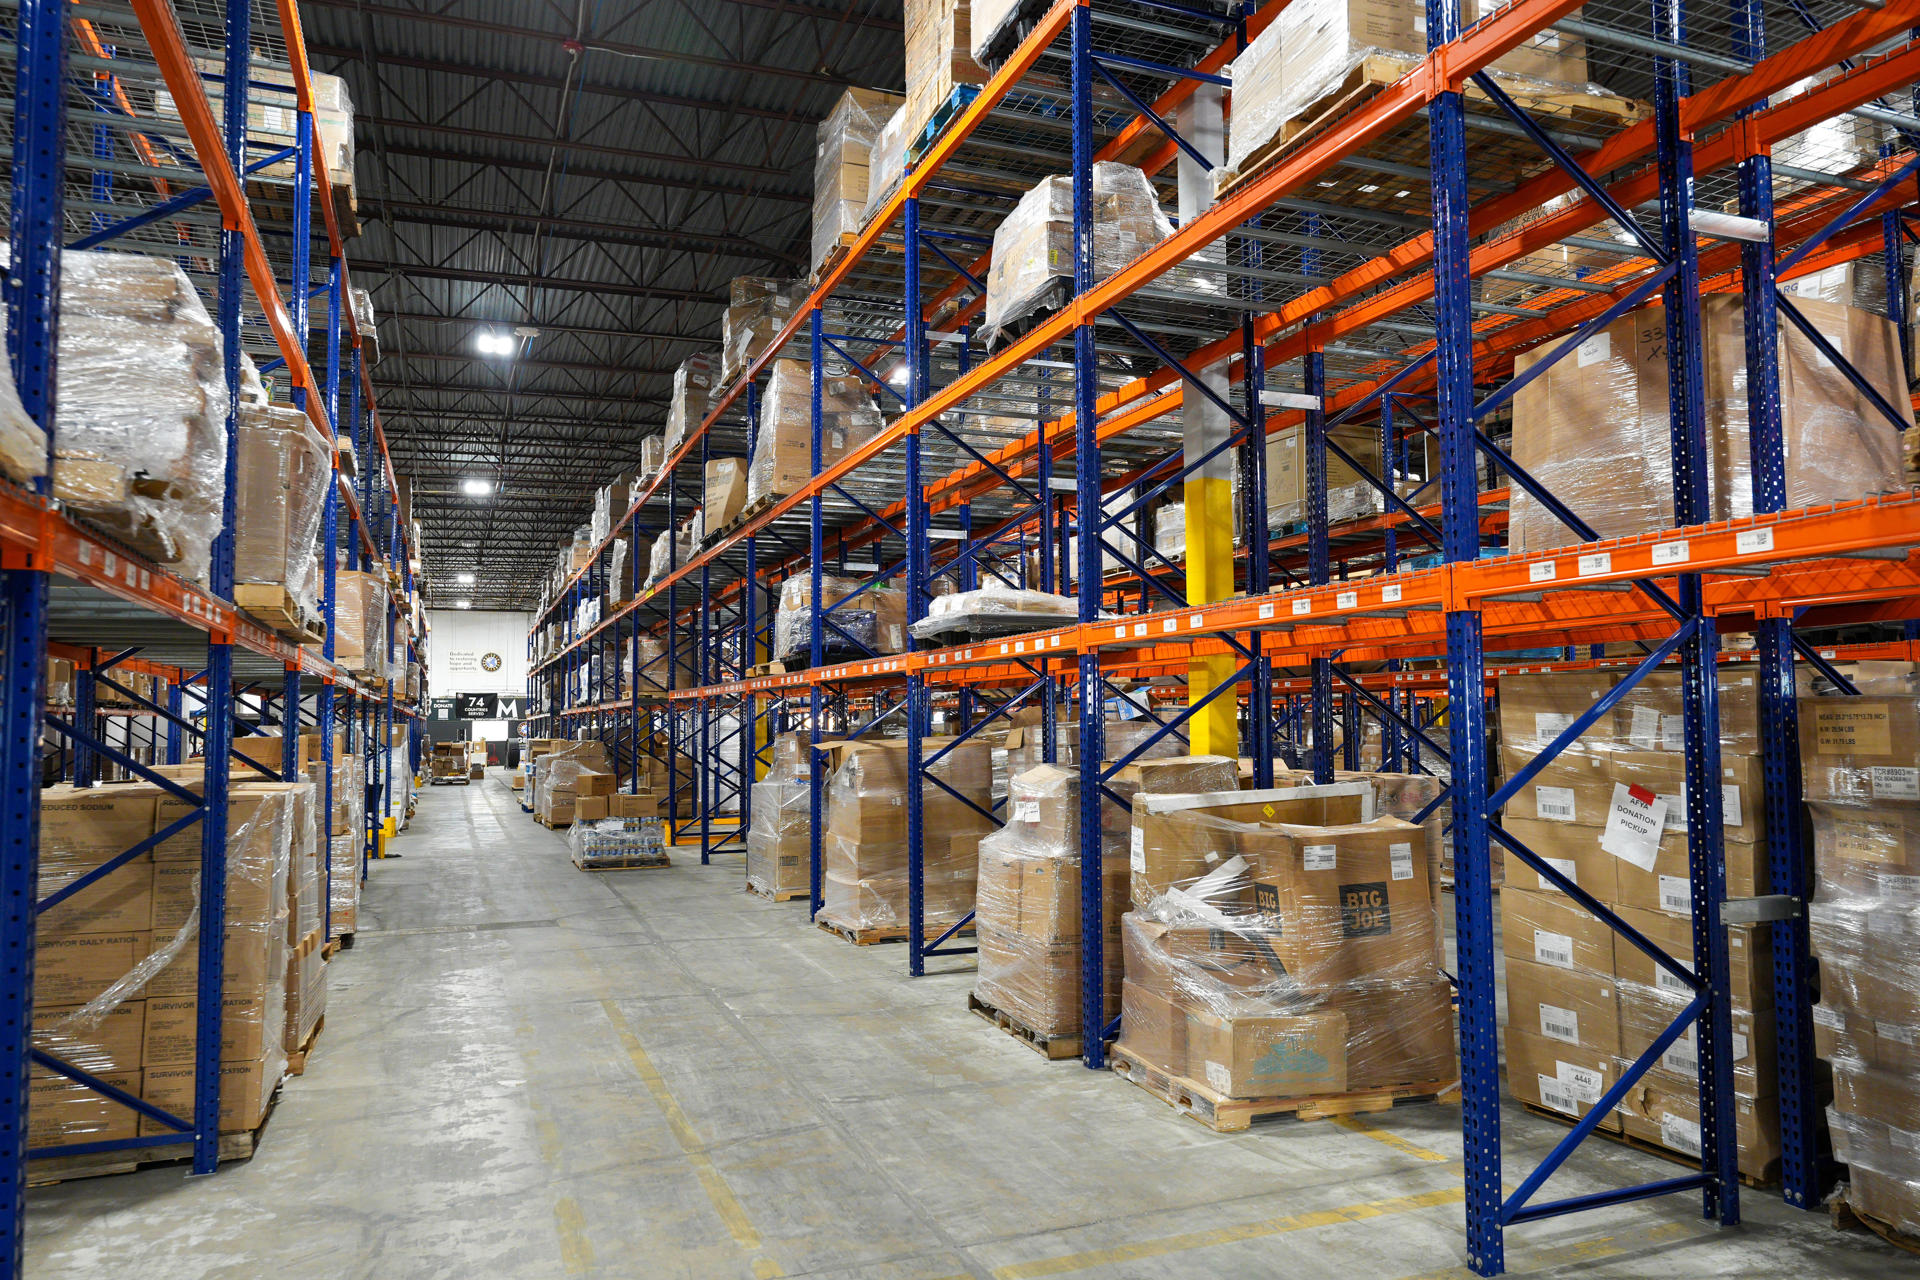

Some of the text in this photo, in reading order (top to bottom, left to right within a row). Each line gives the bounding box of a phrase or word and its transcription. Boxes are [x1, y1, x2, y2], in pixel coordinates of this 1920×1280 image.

[468, 696, 485, 707] 74
[1630, 798, 1649, 810] AFYA
[1617, 805, 1657, 826] DONATION
[1620, 818, 1648, 835] PICKUP
[1258, 890, 1277, 909] BIG
[1346, 890, 1382, 909] BIG
[1350, 910, 1385, 929] JOE
[106, 936, 139, 944] RATION
[151, 1002, 195, 1010] SURVIVOR
[150, 1070, 193, 1079] SURVIVOR
